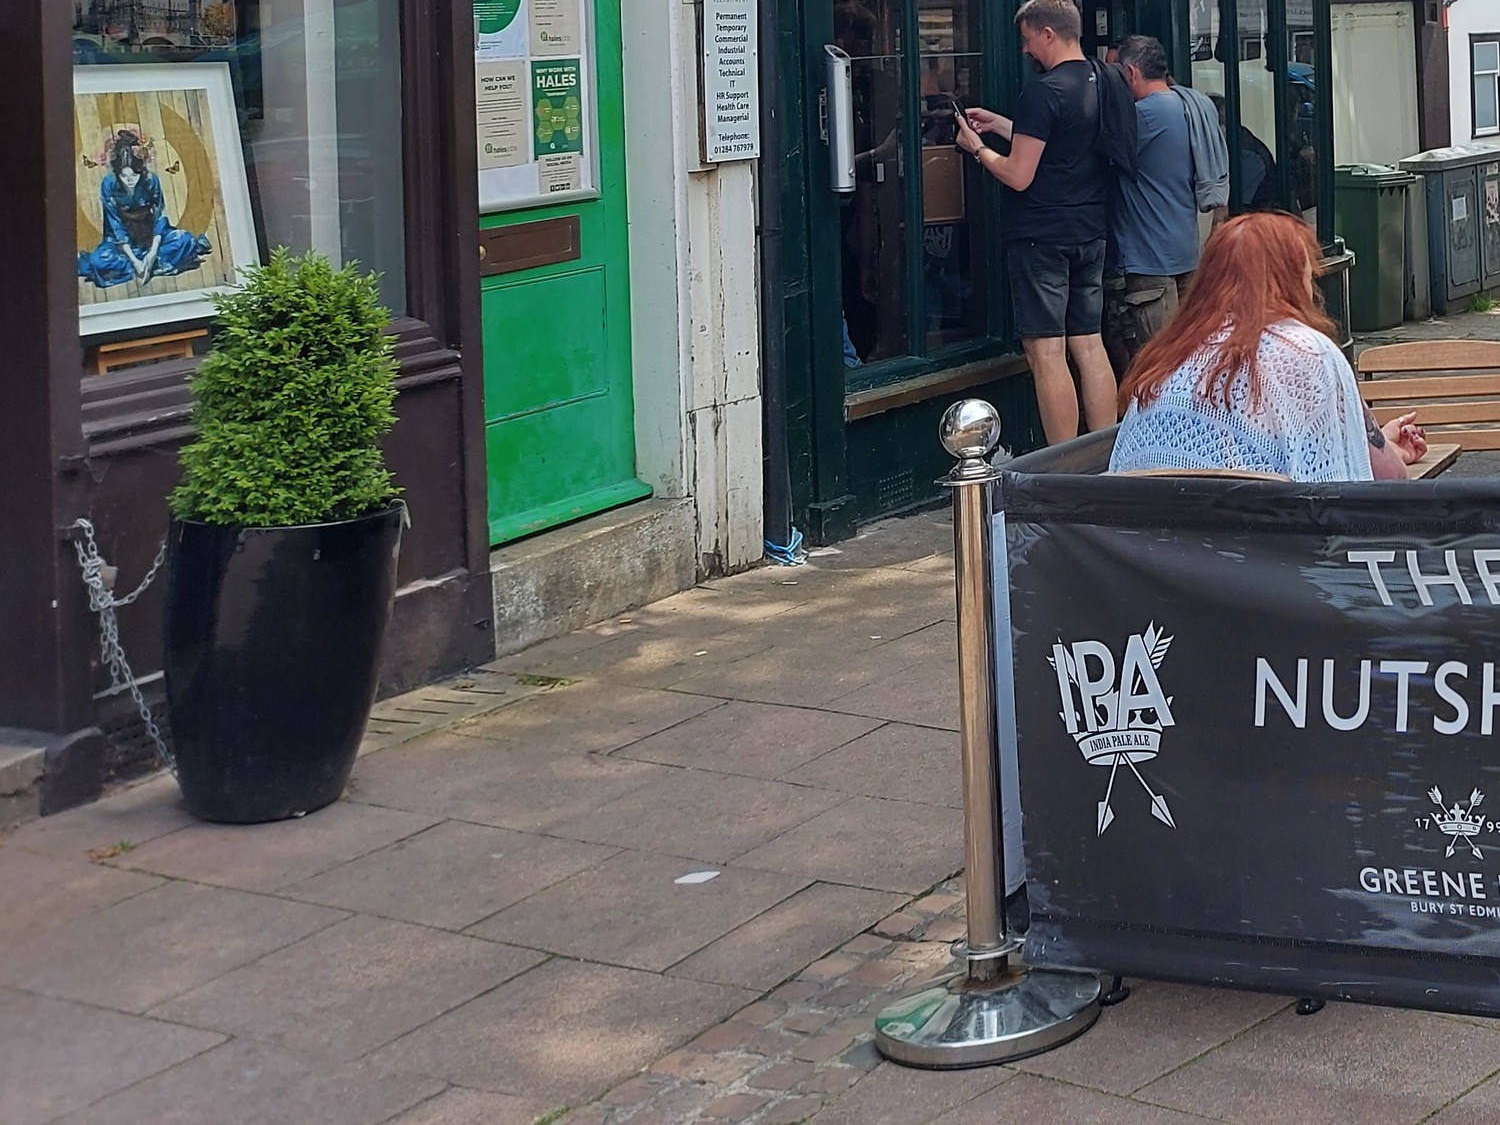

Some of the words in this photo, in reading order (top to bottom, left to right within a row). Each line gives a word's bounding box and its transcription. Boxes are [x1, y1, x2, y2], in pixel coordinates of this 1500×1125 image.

[715, 12, 747, 20] Permanent
[715, 24, 747, 33] Temporary
[714, 34, 749, 43] Commercial
[718, 46, 746, 54] Industrial
[719, 58, 745, 66] Accounts
[718, 68, 746, 77] Technical
[536, 74, 577, 89] HALES
[729, 80, 735, 88] IT
[716, 92, 726, 101] HR
[726, 91, 749, 101] Support
[716, 102, 736, 112] Health
[736, 102, 750, 111] Care
[717, 113, 750, 124] Managerial
[718, 132, 750, 143] Telephone:
[714, 145, 733, 155] 01284
[733, 142, 754, 153] 767979
[1052, 634, 1176, 734] IPA
[1089, 737, 1112, 752] INDIA
[1112, 735, 1132, 748] PALE
[1134, 734, 1150, 746] ALE
[1414, 817, 1430, 830] 17
[1359, 866, 1487, 900] GREENE
[1410, 901, 1445, 914] BURY
[1449, 903, 1464, 916] ST
